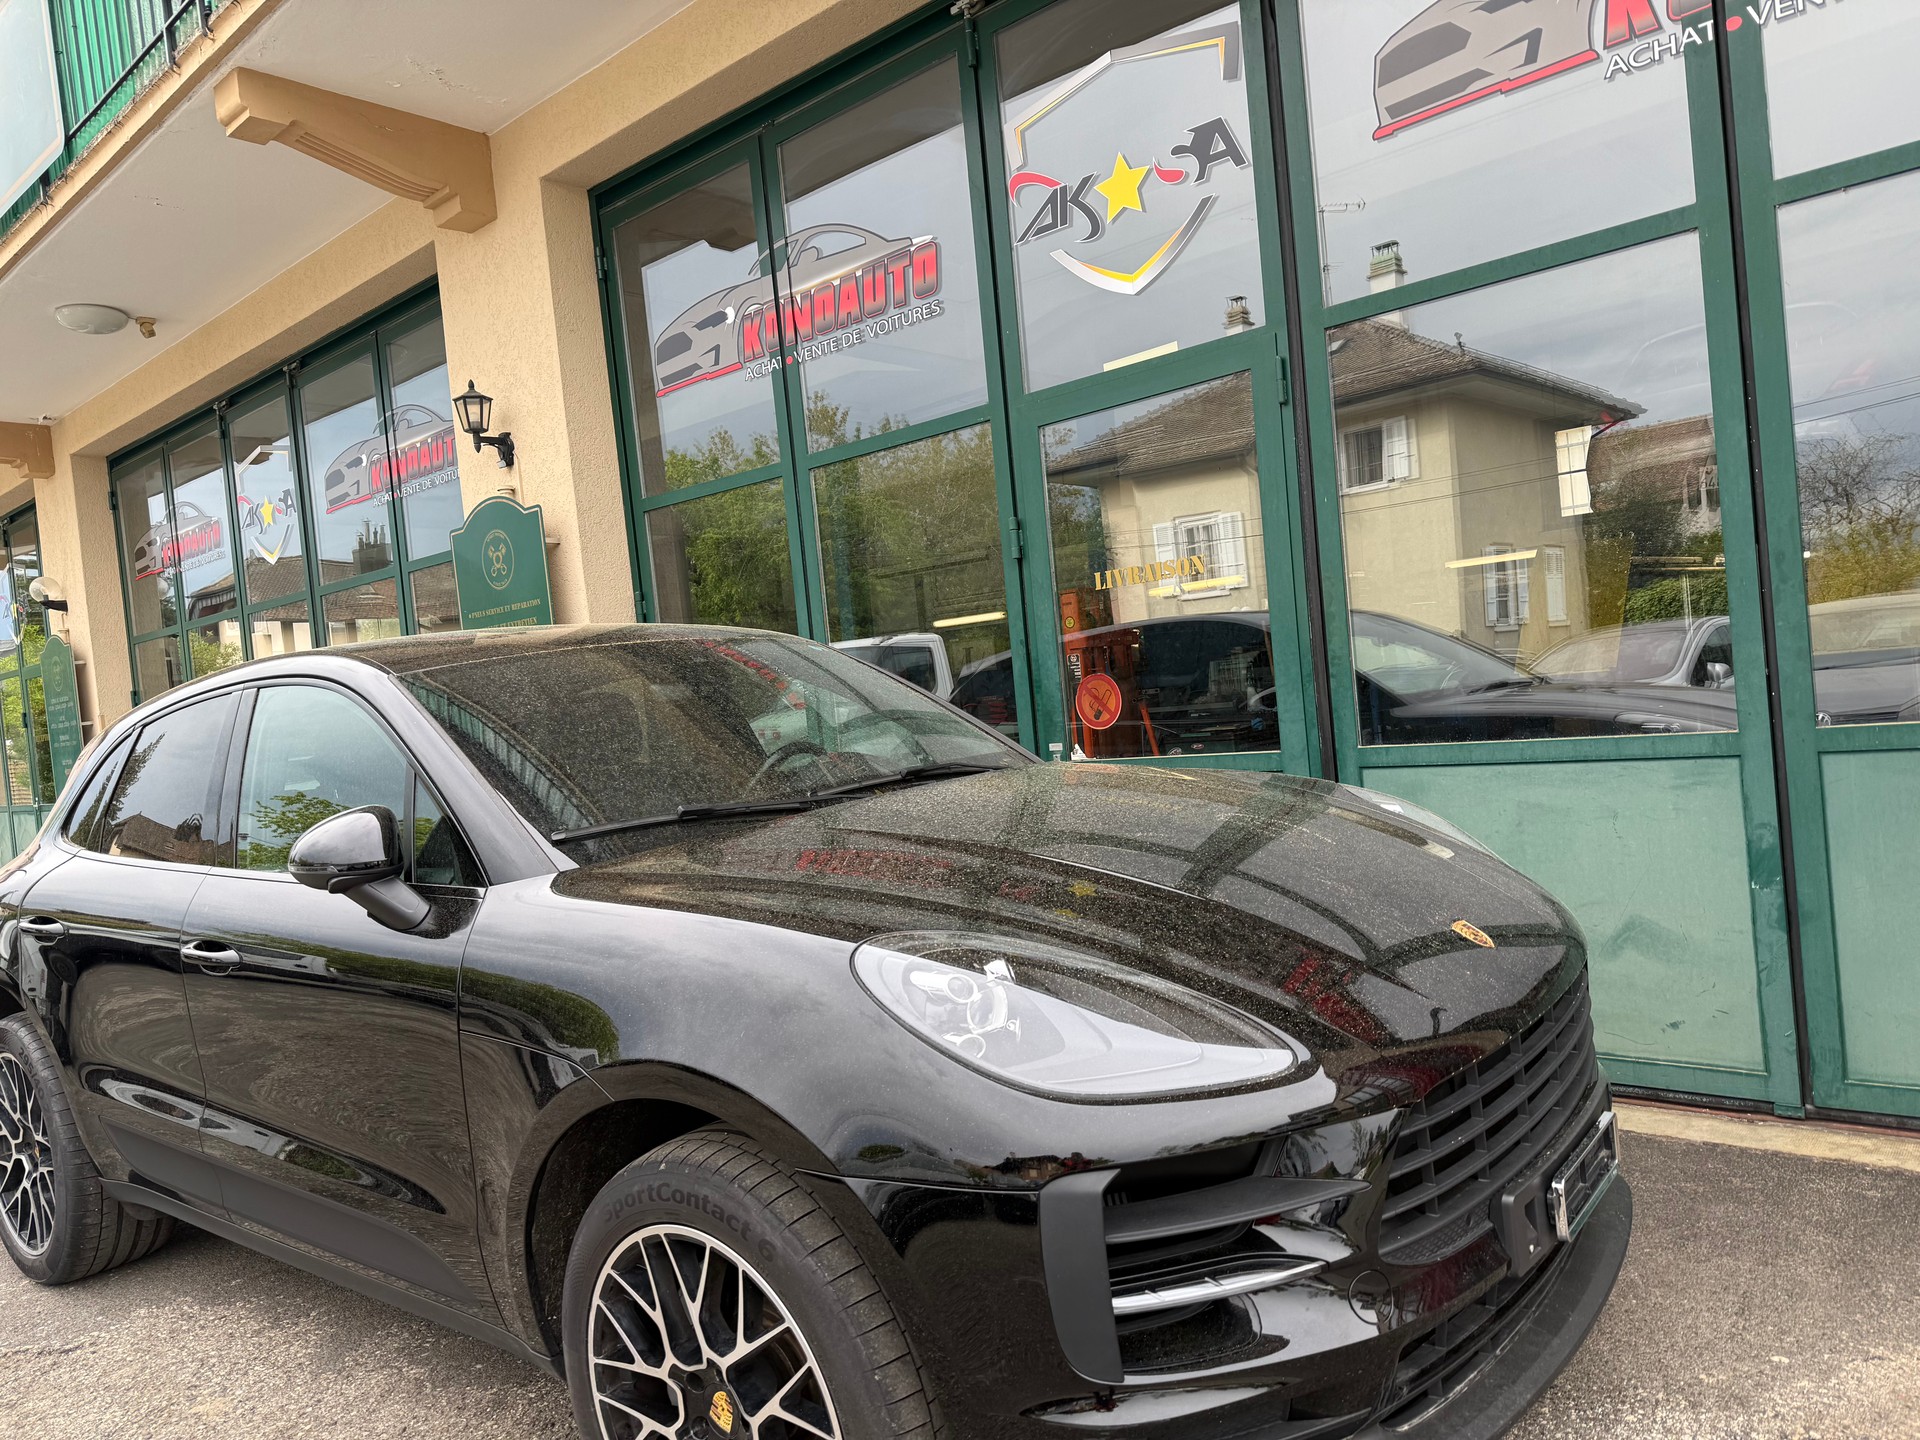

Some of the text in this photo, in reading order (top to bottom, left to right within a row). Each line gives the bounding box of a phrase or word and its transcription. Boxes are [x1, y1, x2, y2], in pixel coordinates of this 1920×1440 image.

[1604, 19, 1714, 80] ACHAT
[745, 300, 941, 381] ACHAT VENTE DE VOITURES
[371, 430, 455, 493] KONOAUT
[397, 482, 421, 498] VENTE
[422, 478, 433, 490] DE
[434, 468, 460, 485] VOITU
[1094, 554, 1206, 591] LIVRAISON
